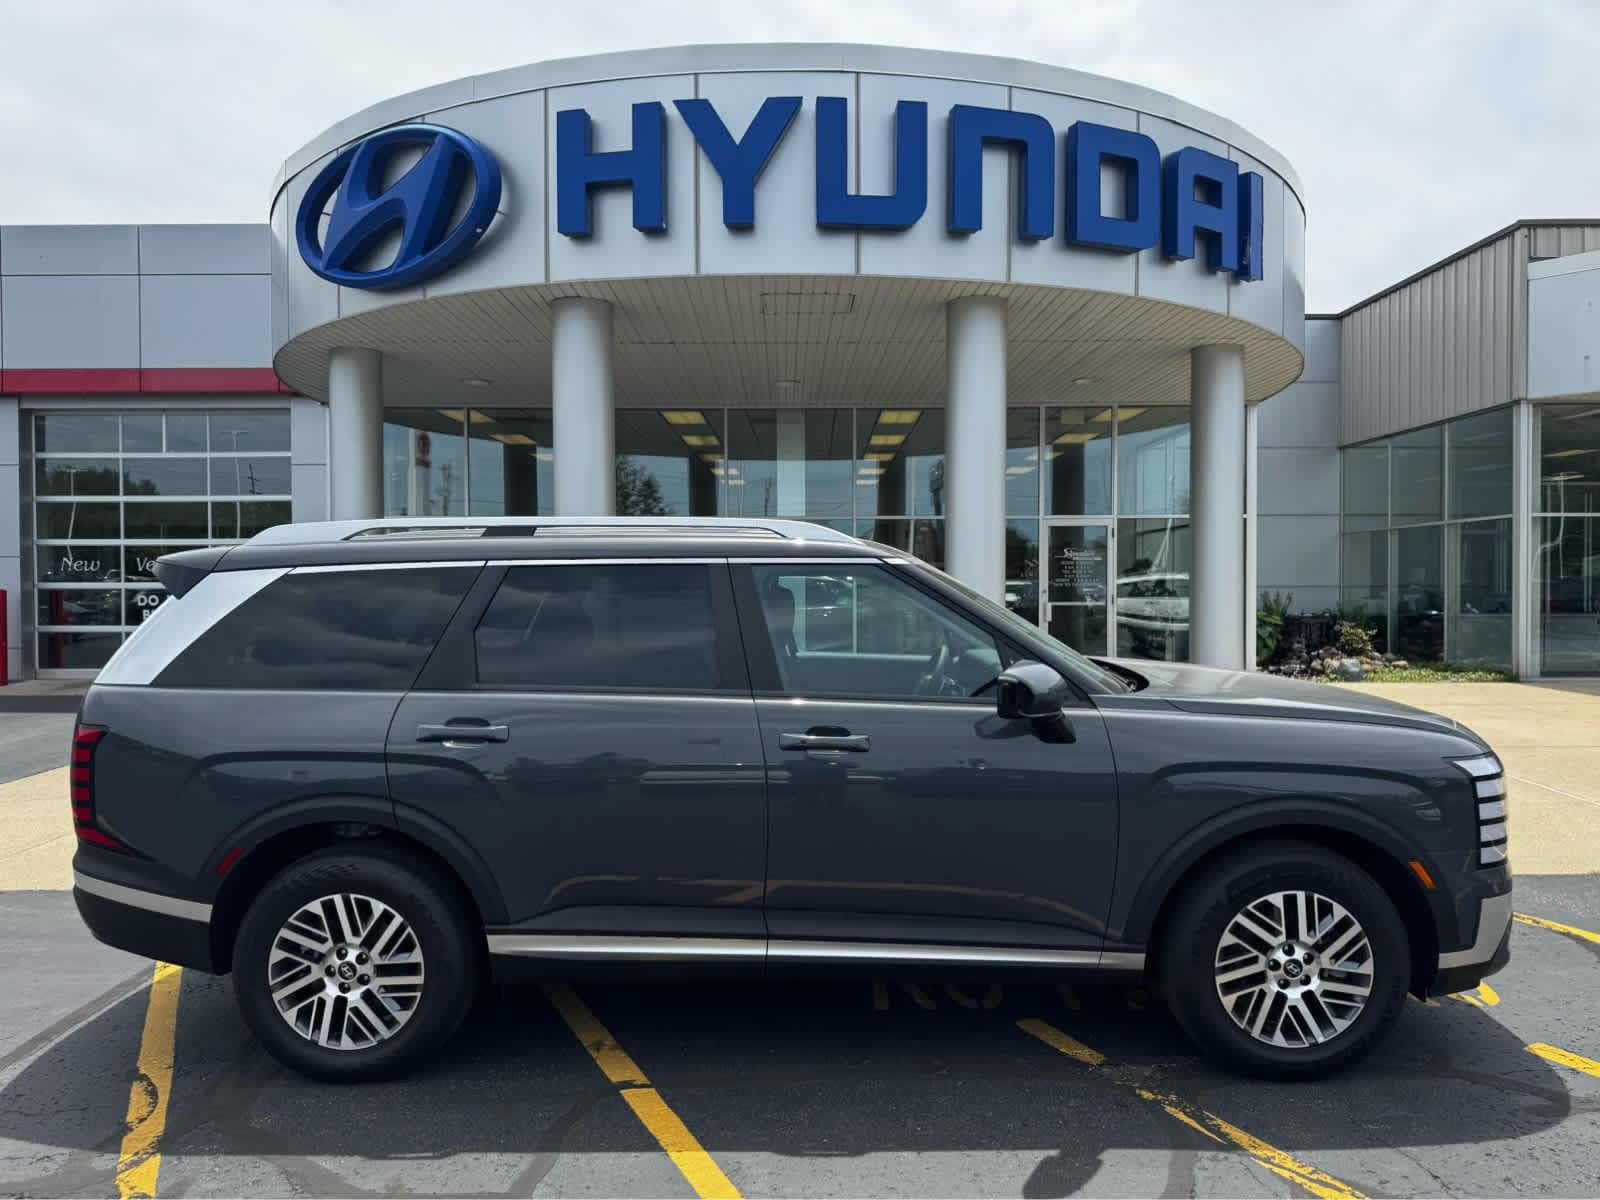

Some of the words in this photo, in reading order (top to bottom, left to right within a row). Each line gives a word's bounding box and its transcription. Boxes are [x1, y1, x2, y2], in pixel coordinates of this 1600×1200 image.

[557, 96, 1264, 282] HYUNDAI
[60, 557, 100, 572] New
[137, 595, 159, 606] DO
